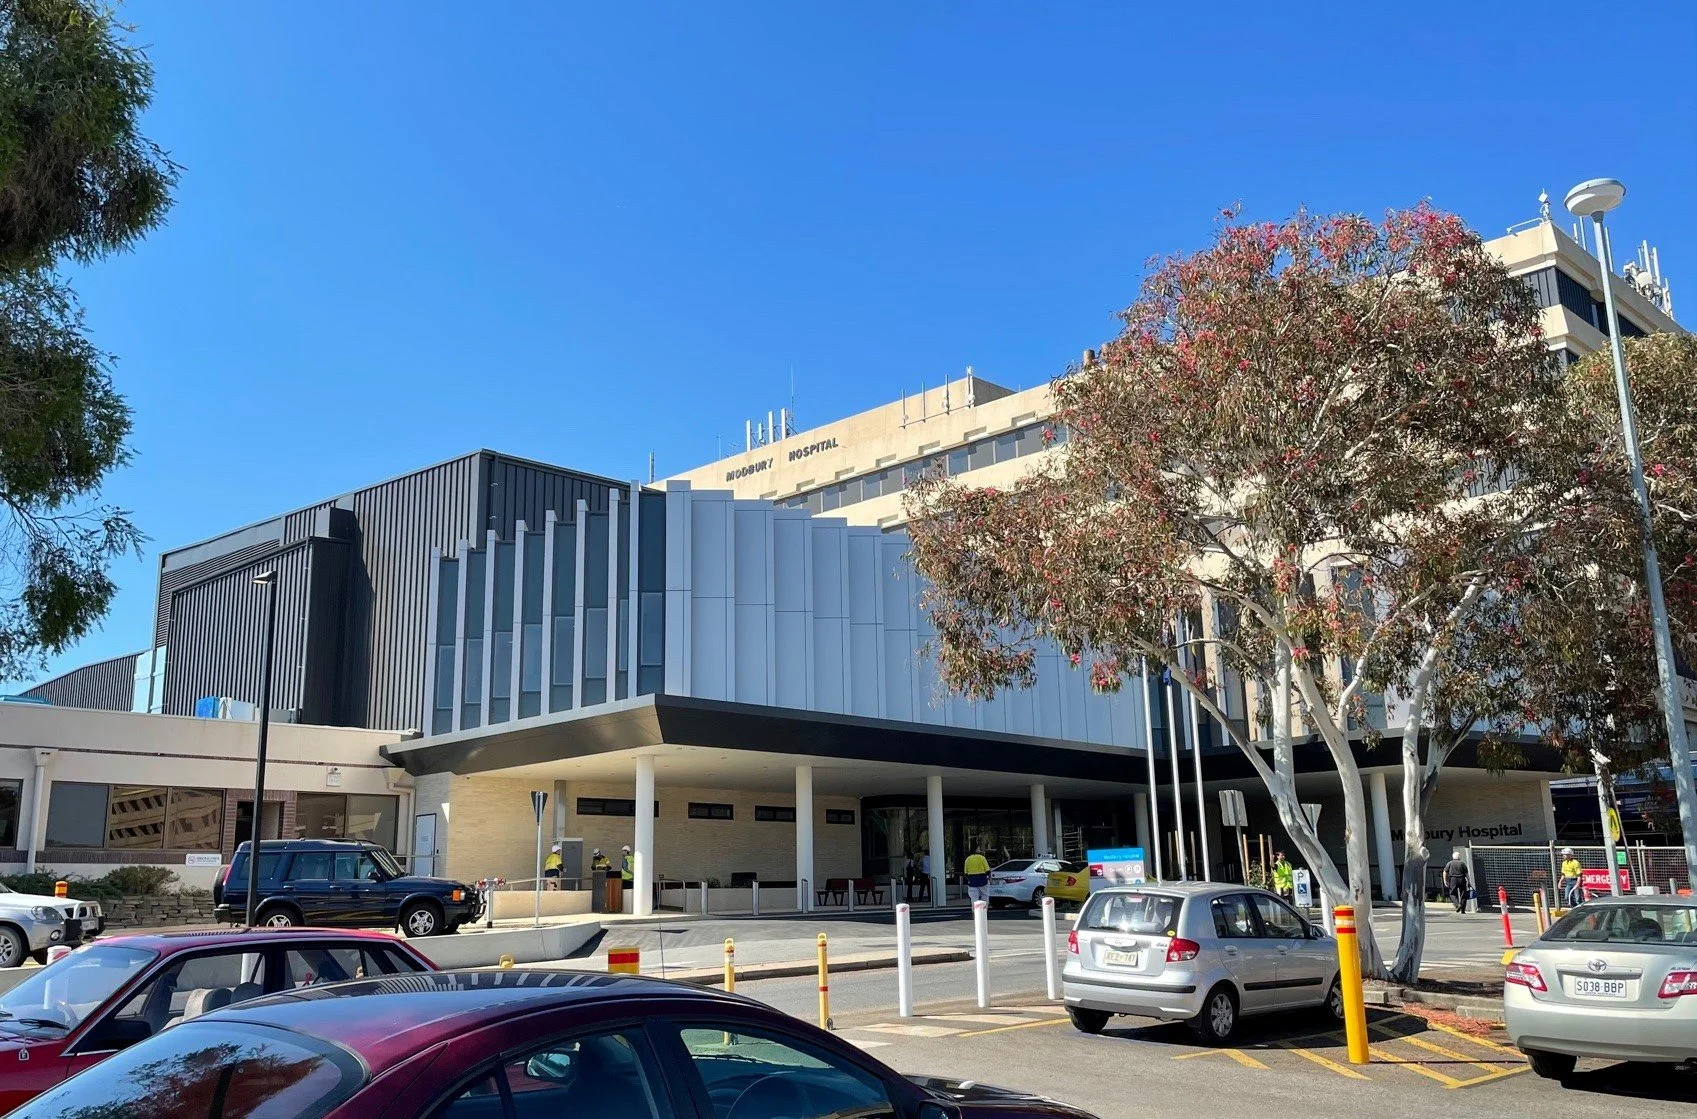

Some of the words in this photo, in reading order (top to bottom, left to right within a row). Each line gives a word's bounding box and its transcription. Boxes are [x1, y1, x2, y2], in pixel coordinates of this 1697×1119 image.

[726, 458, 773, 482] MODBURY
[788, 437, 839, 462] HOSPITAL
[1459, 823, 1522, 839] Hospital
[1297, 871, 1304, 881] P
[1582, 873, 1628, 885] EMERGEY
